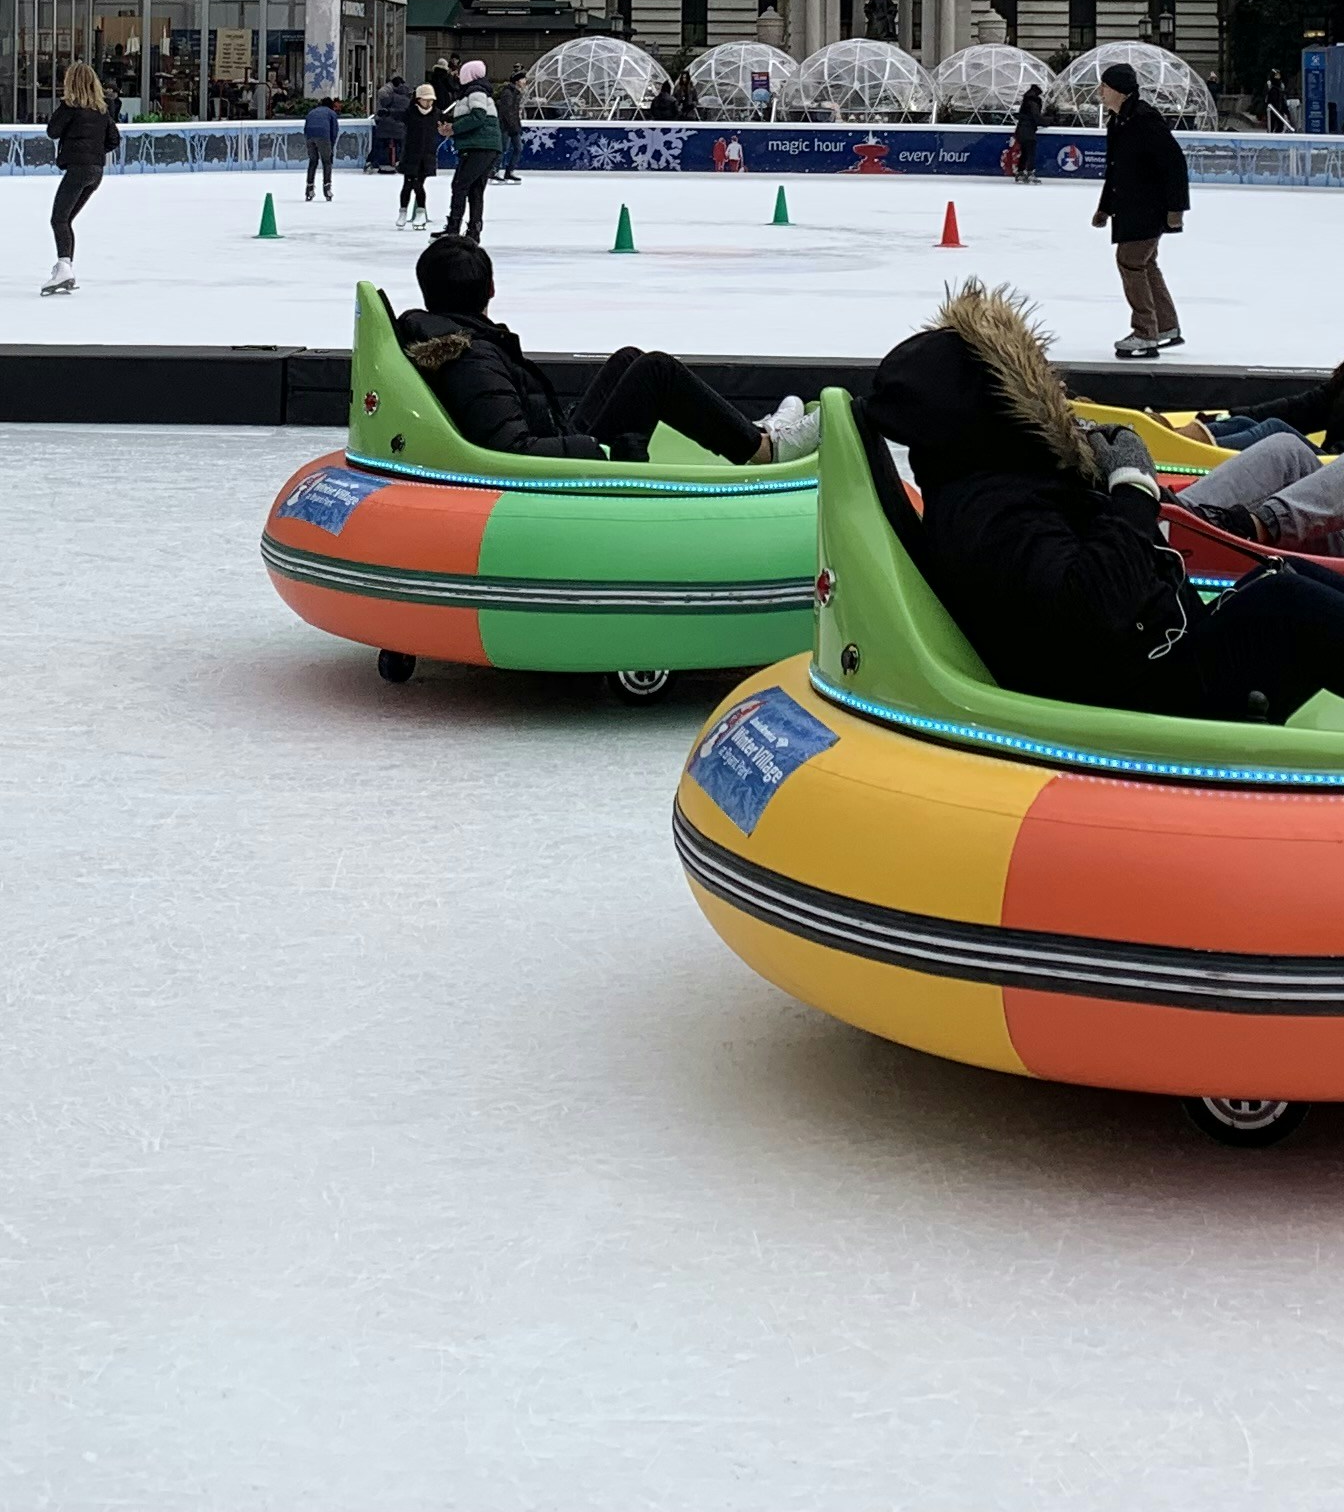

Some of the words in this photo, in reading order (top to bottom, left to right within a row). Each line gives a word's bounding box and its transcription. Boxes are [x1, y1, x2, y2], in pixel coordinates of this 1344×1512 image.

[768, 139, 810, 156] magic
[814, 138, 847, 152] hour
[899, 151, 936, 166] every
[938, 149, 971, 163] hour
[1084, 155, 1106, 163] Winte
[731, 725, 759, 757] Winter
[752, 745, 783, 784] Village
